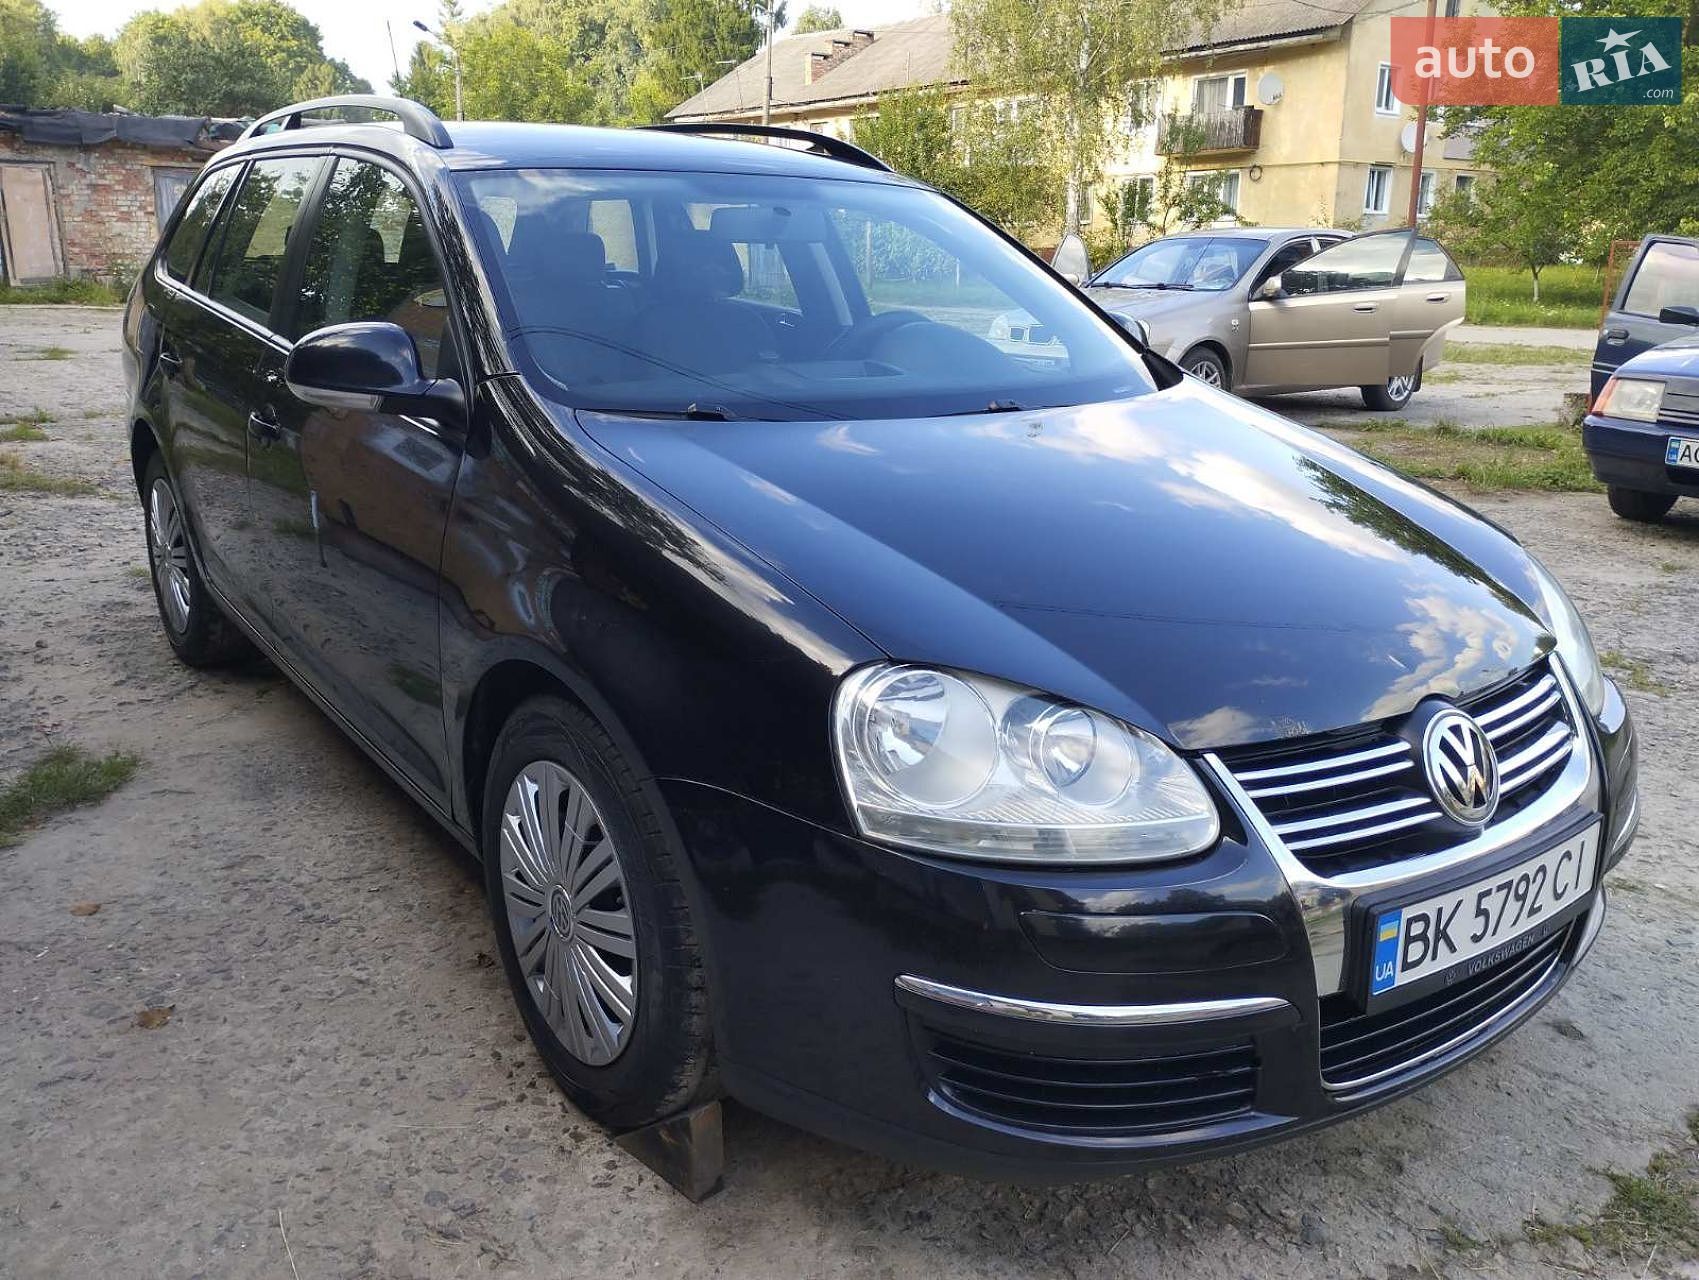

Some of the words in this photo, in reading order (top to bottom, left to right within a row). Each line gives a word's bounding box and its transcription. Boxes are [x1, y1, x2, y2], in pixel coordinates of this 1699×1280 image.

[1401, 898, 1464, 973] BK
[1470, 864, 1547, 944] 5792
[1553, 840, 1585, 901] CI
[1375, 963, 1395, 981] UA
